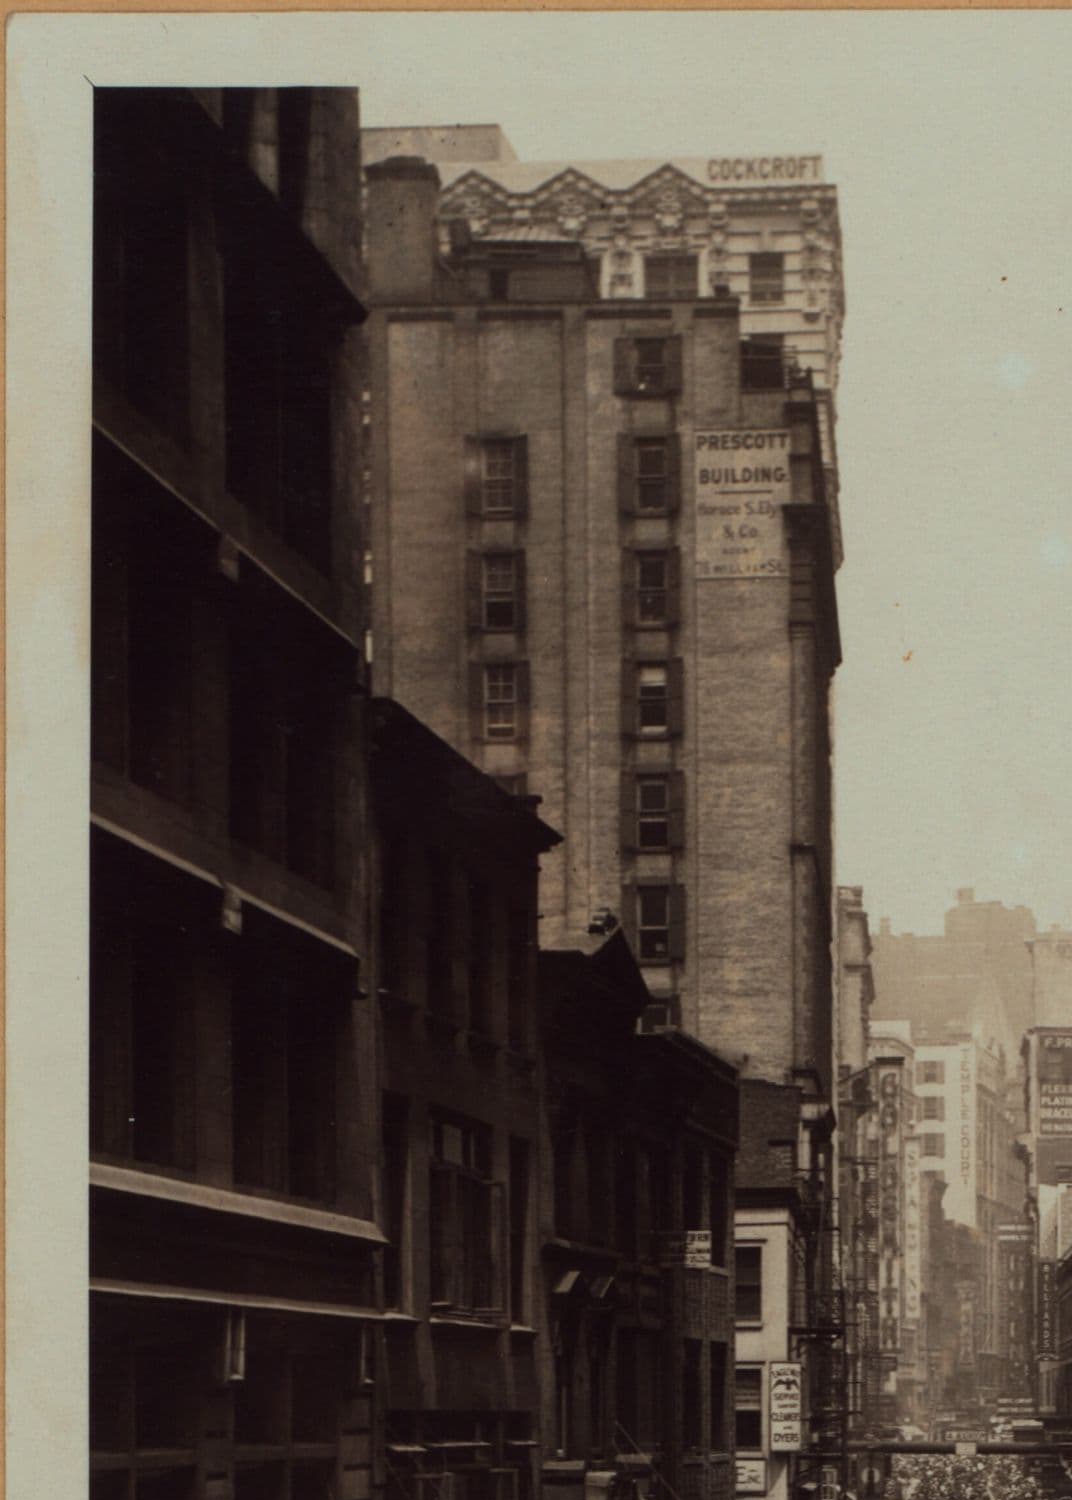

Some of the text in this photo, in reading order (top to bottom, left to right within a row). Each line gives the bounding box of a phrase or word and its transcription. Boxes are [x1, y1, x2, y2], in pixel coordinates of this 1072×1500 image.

[708, 155, 822, 180] COCKCROFT
[696, 433, 788, 450] PRESCOTT
[700, 467, 788, 484] BUILDING
[960, 1125, 971, 1185] COURT
[774, 1432, 800, 1443] DYERS
